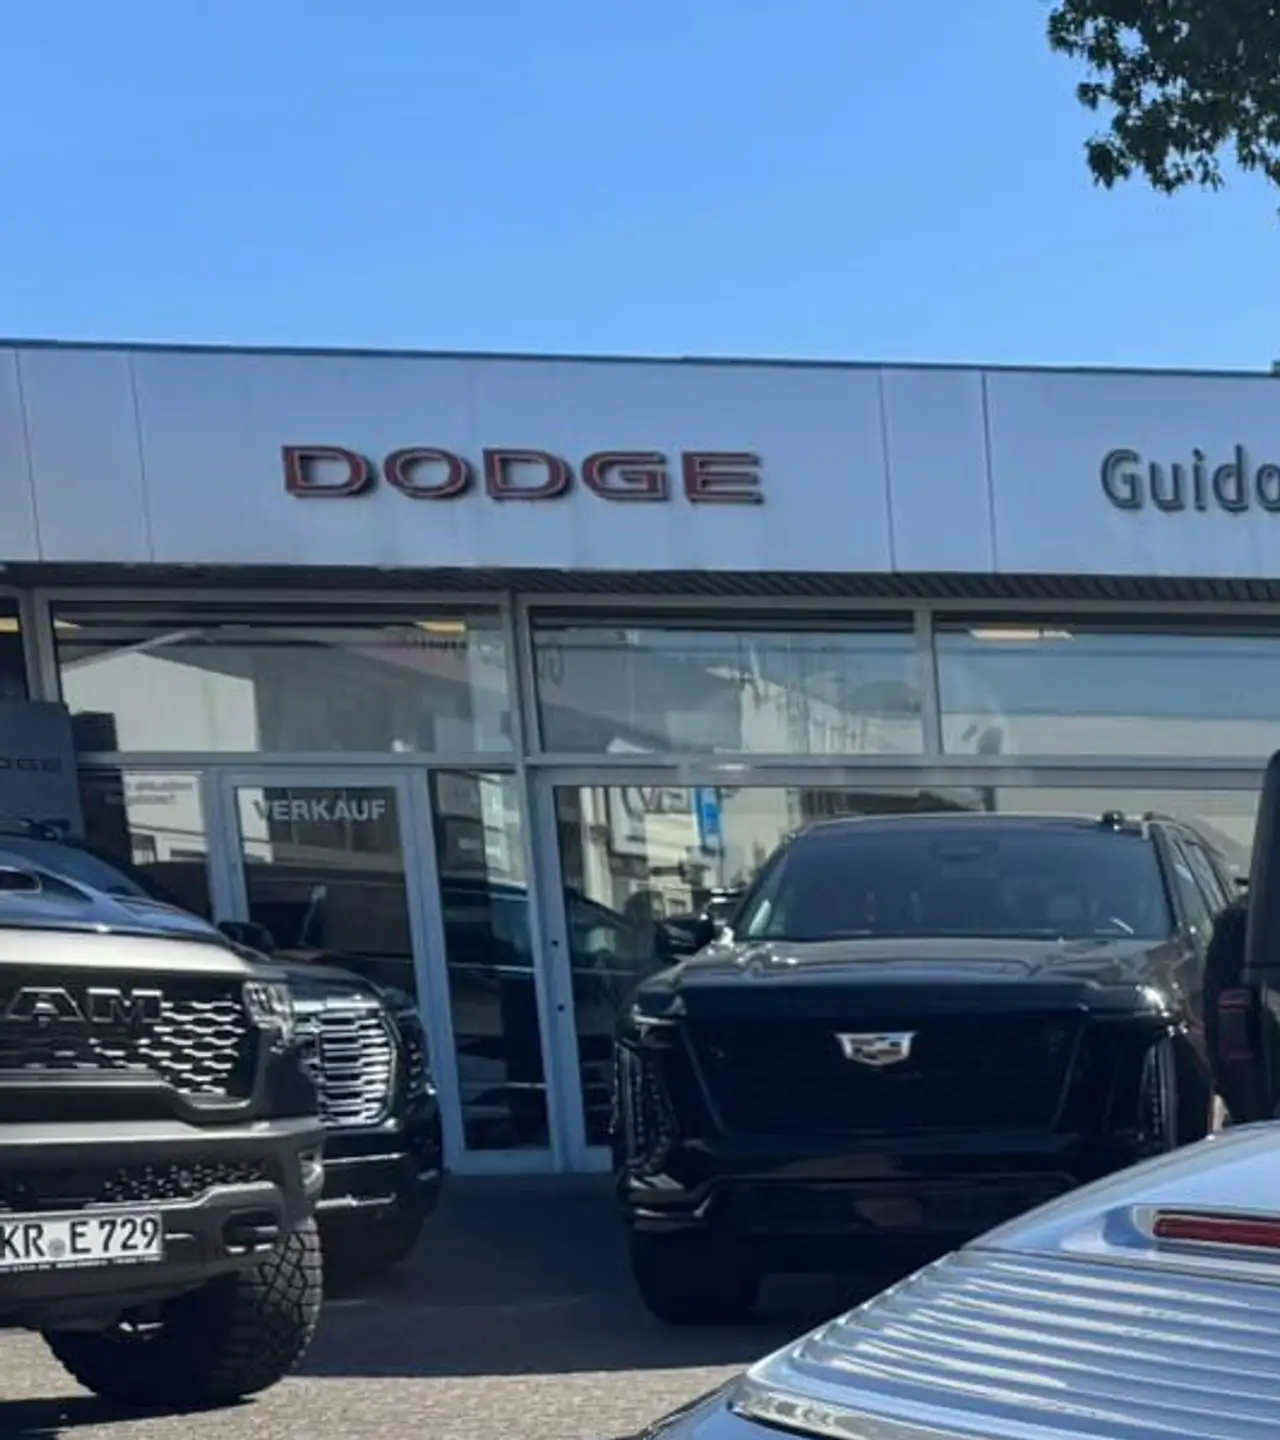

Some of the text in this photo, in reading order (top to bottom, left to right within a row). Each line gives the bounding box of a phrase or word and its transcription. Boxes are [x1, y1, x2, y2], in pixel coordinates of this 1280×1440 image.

[282, 446, 764, 504] DODGE
[252, 799, 386, 821] VERKAUF
[0, 986, 163, 1024] AM
[0, 1217, 160, 1258] KR E 729
